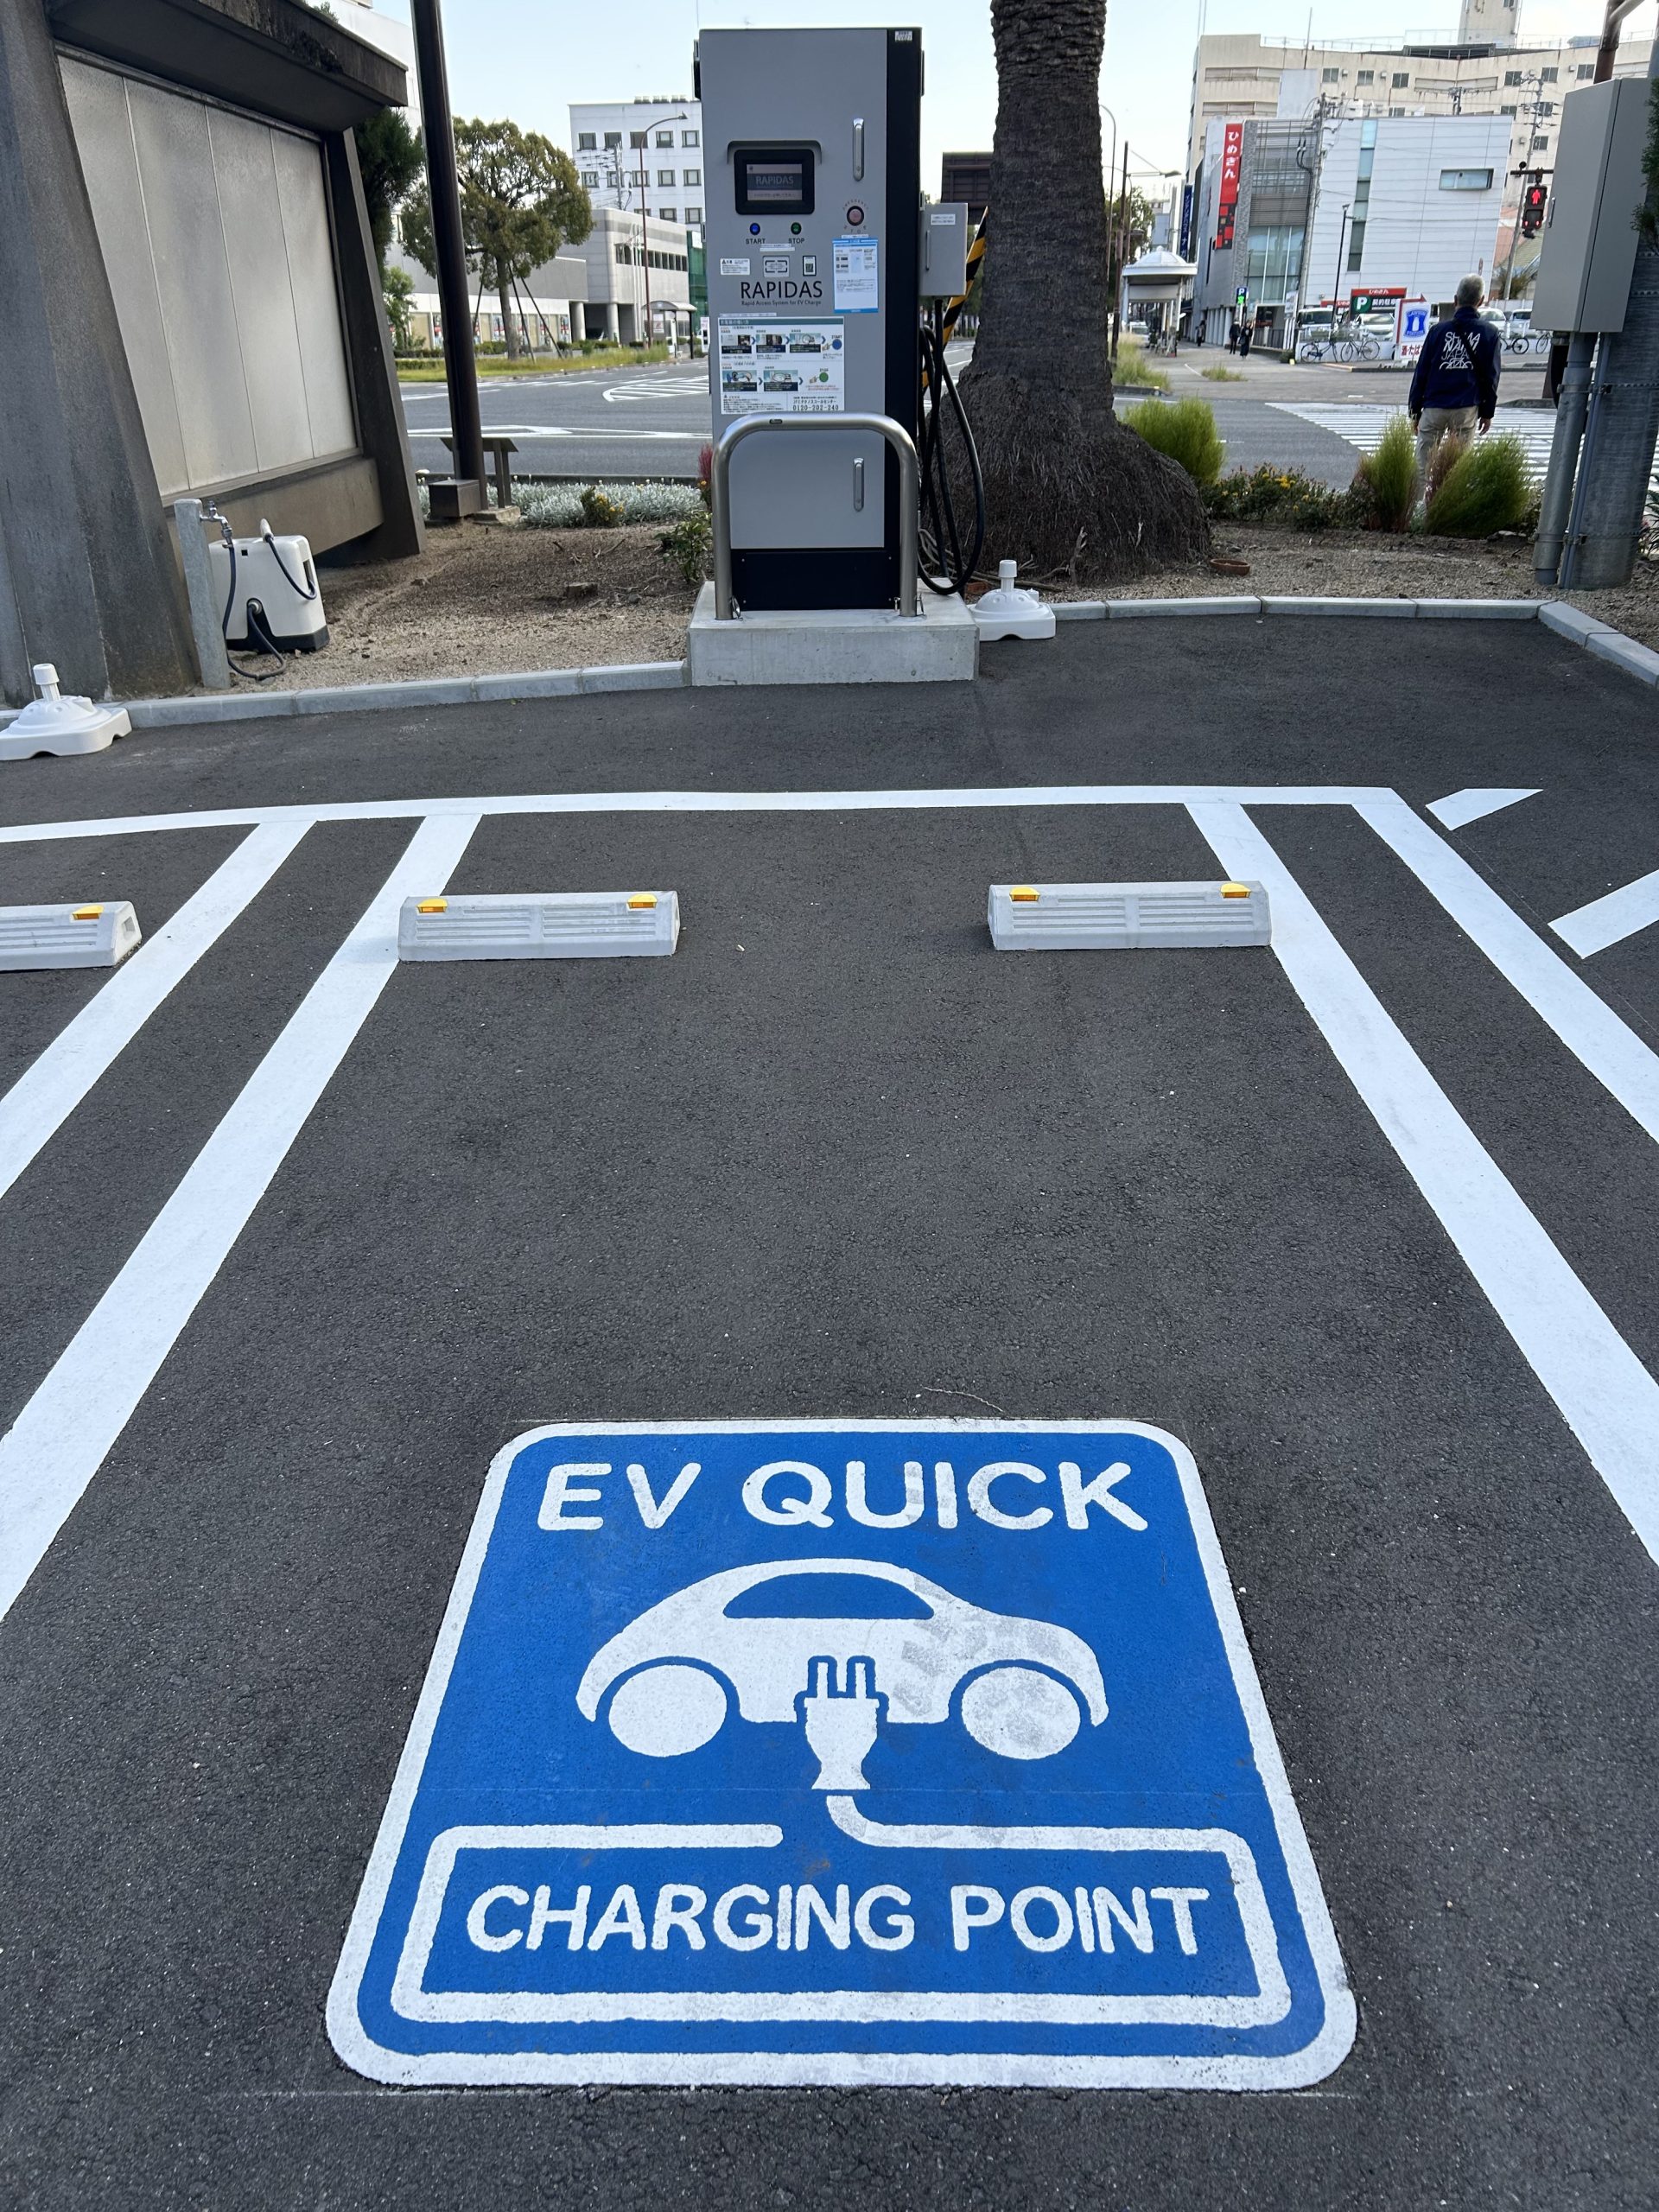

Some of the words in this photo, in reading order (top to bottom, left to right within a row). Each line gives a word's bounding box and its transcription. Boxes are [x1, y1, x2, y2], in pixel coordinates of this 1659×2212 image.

[1224, 131, 1239, 180] ひめぎん
[755, 175, 794, 185] RAPIDAS
[741, 281, 823, 299] RAPIDAS
[1357, 296, 1368, 310] P
[1445, 331, 1481, 343] SHMA
[537, 1462, 702, 1531] EV
[741, 1460, 1148, 1531] QUICK
[466, 1883, 915, 1953] CHARGING
[950, 1885, 1211, 1955] POINT
